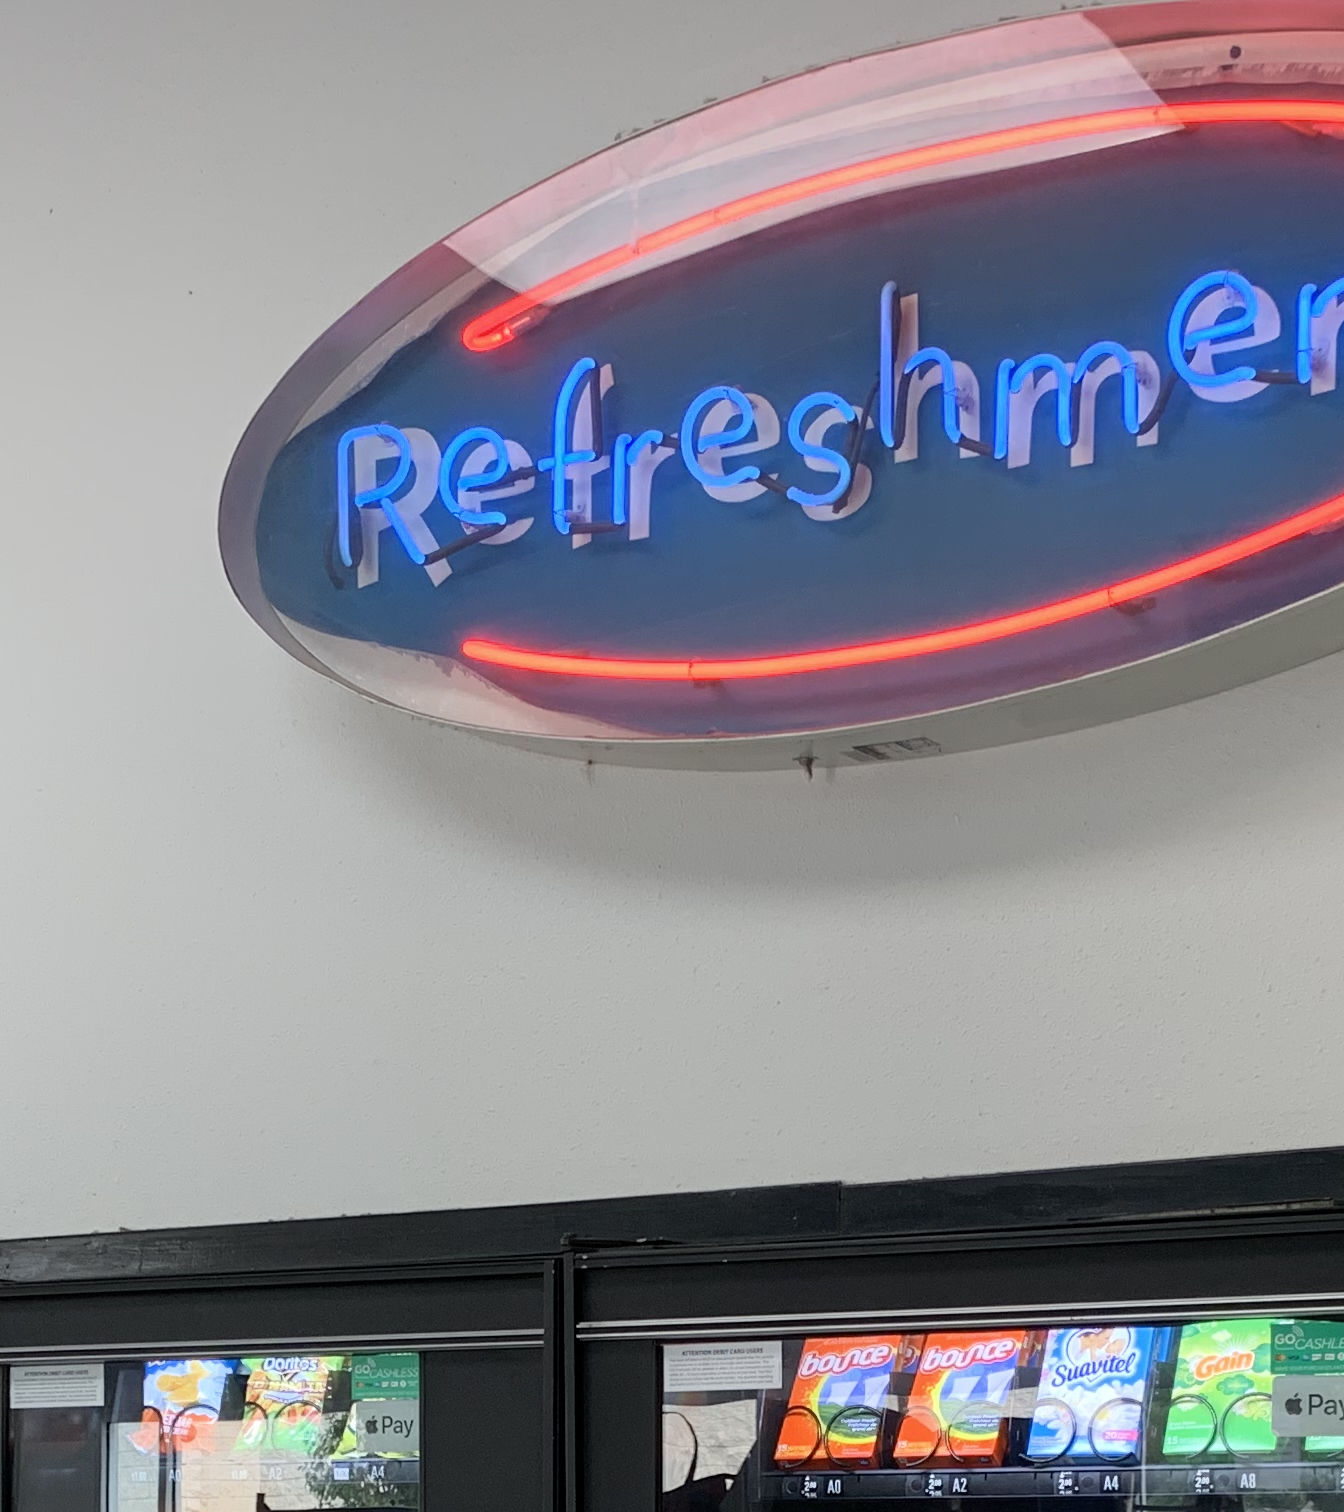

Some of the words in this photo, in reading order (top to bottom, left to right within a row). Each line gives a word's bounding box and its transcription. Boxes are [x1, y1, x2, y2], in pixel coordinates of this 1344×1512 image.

[1275, 1333, 1295, 1344] GO
[803, 1346, 891, 1376] bounce
[924, 1340, 1015, 1371] bounce
[263, 1357, 318, 1372] Doritos
[356, 1365, 370, 1375] GO
[370, 1366, 418, 1378] CASHLESS
[1052, 1353, 1136, 1387] Suavitel
[1195, 1353, 1253, 1379] Gain
[382, 1416, 414, 1438] Pay
[953, 1477, 967, 1493] A2
[1104, 1476, 1119, 1491] A4
[1240, 1473, 1255, 1488] A8
